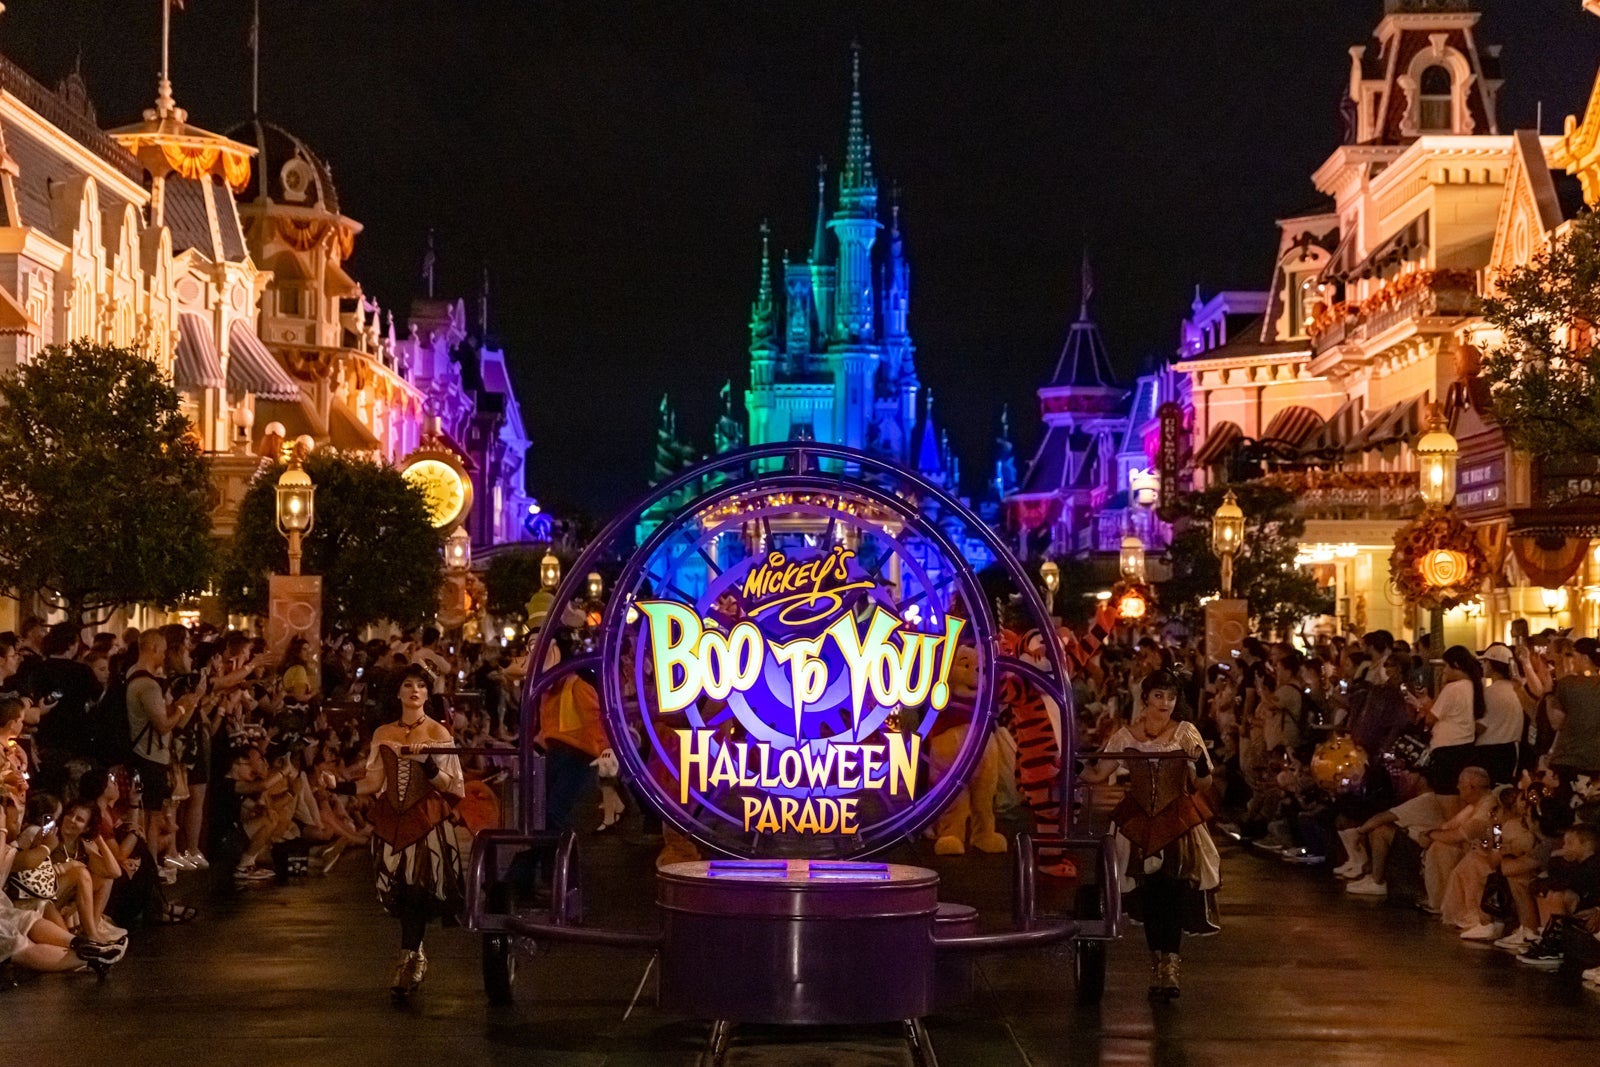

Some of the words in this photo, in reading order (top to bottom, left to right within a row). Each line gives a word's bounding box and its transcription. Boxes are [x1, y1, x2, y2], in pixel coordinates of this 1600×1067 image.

[743, 546, 858, 604] MICKEY'S
[675, 729, 922, 805] HALLOWEEN
[742, 797, 860, 834] PARADE
